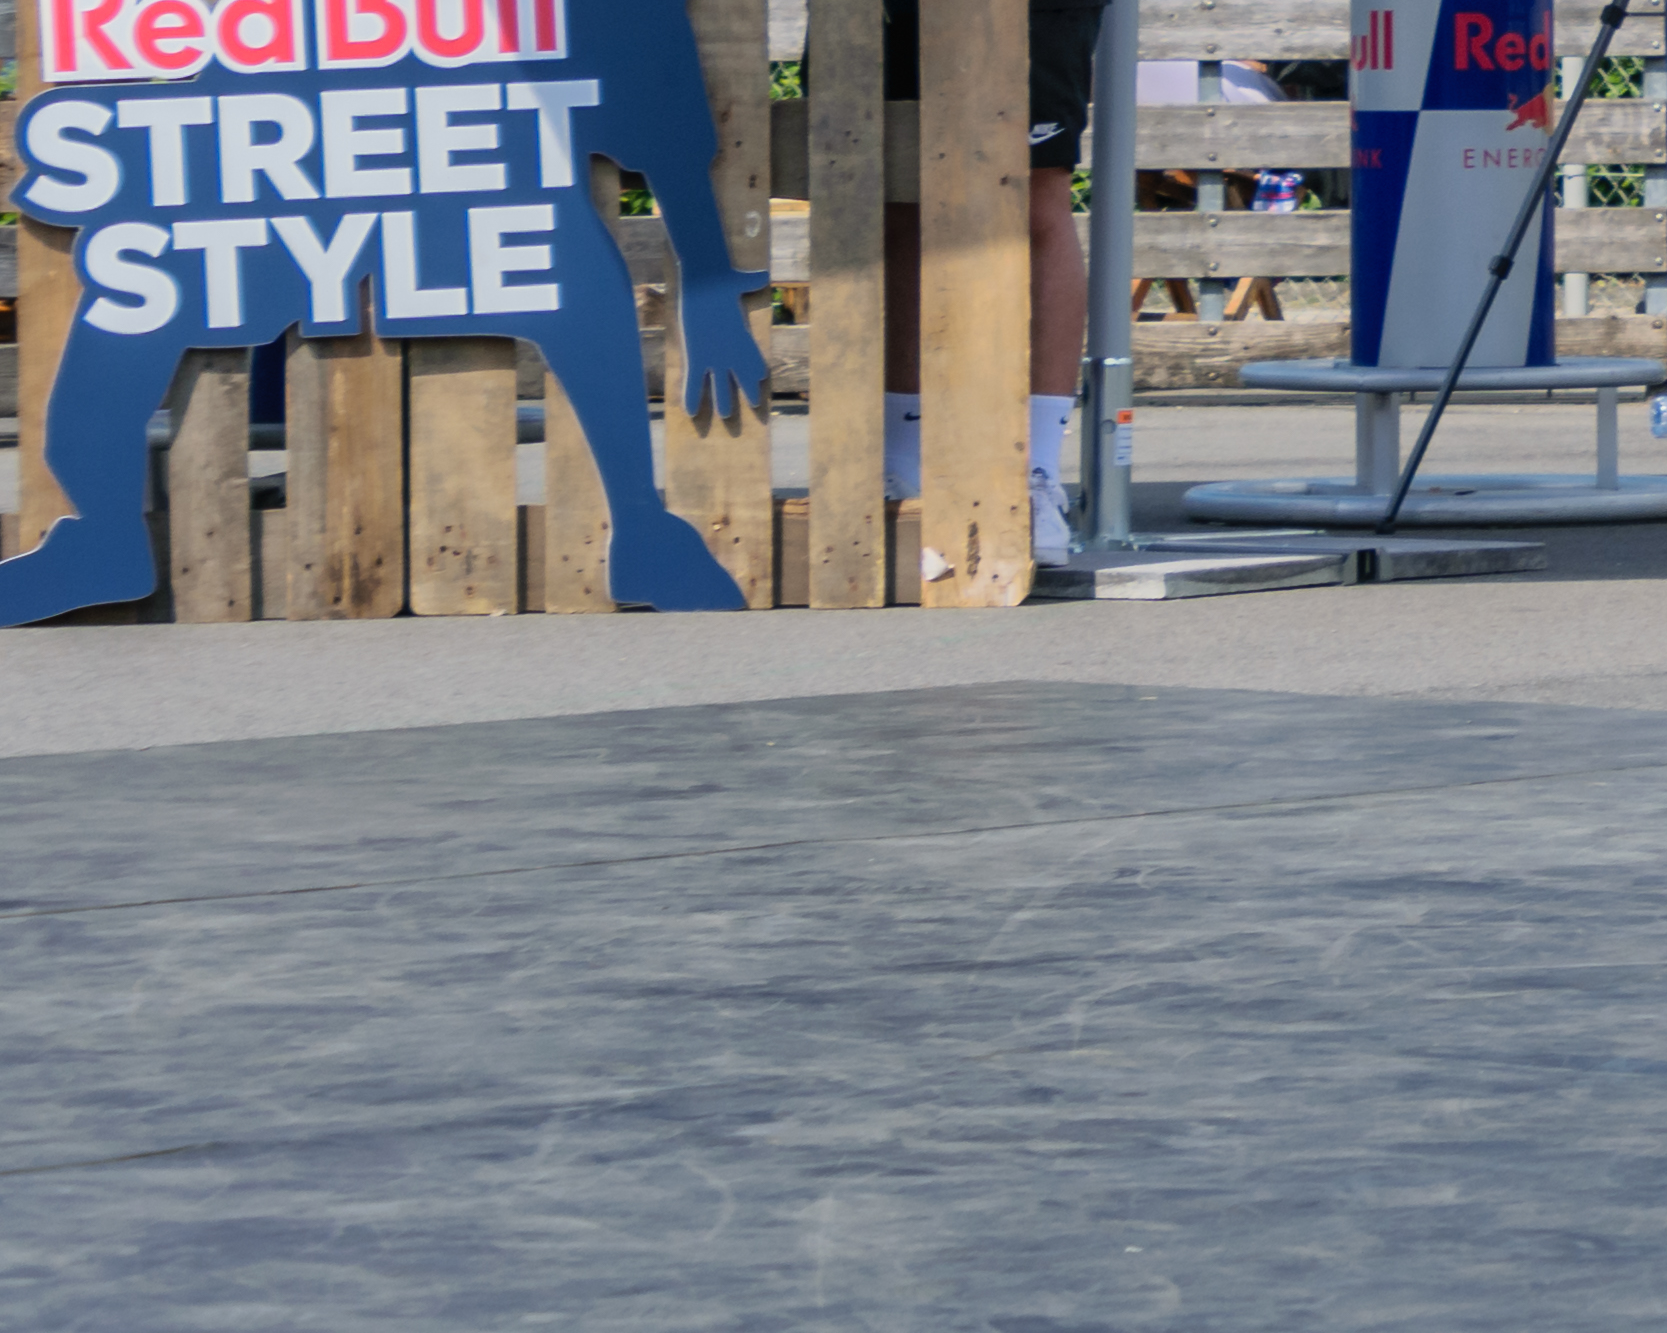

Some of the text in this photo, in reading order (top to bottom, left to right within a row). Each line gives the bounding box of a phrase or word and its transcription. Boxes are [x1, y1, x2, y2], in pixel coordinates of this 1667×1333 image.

[1350, 10, 1394, 71] ull
[1454, 11, 1552, 71] Red
[24, 79, 600, 213] STREET
[83, 204, 561, 334] STYLE
